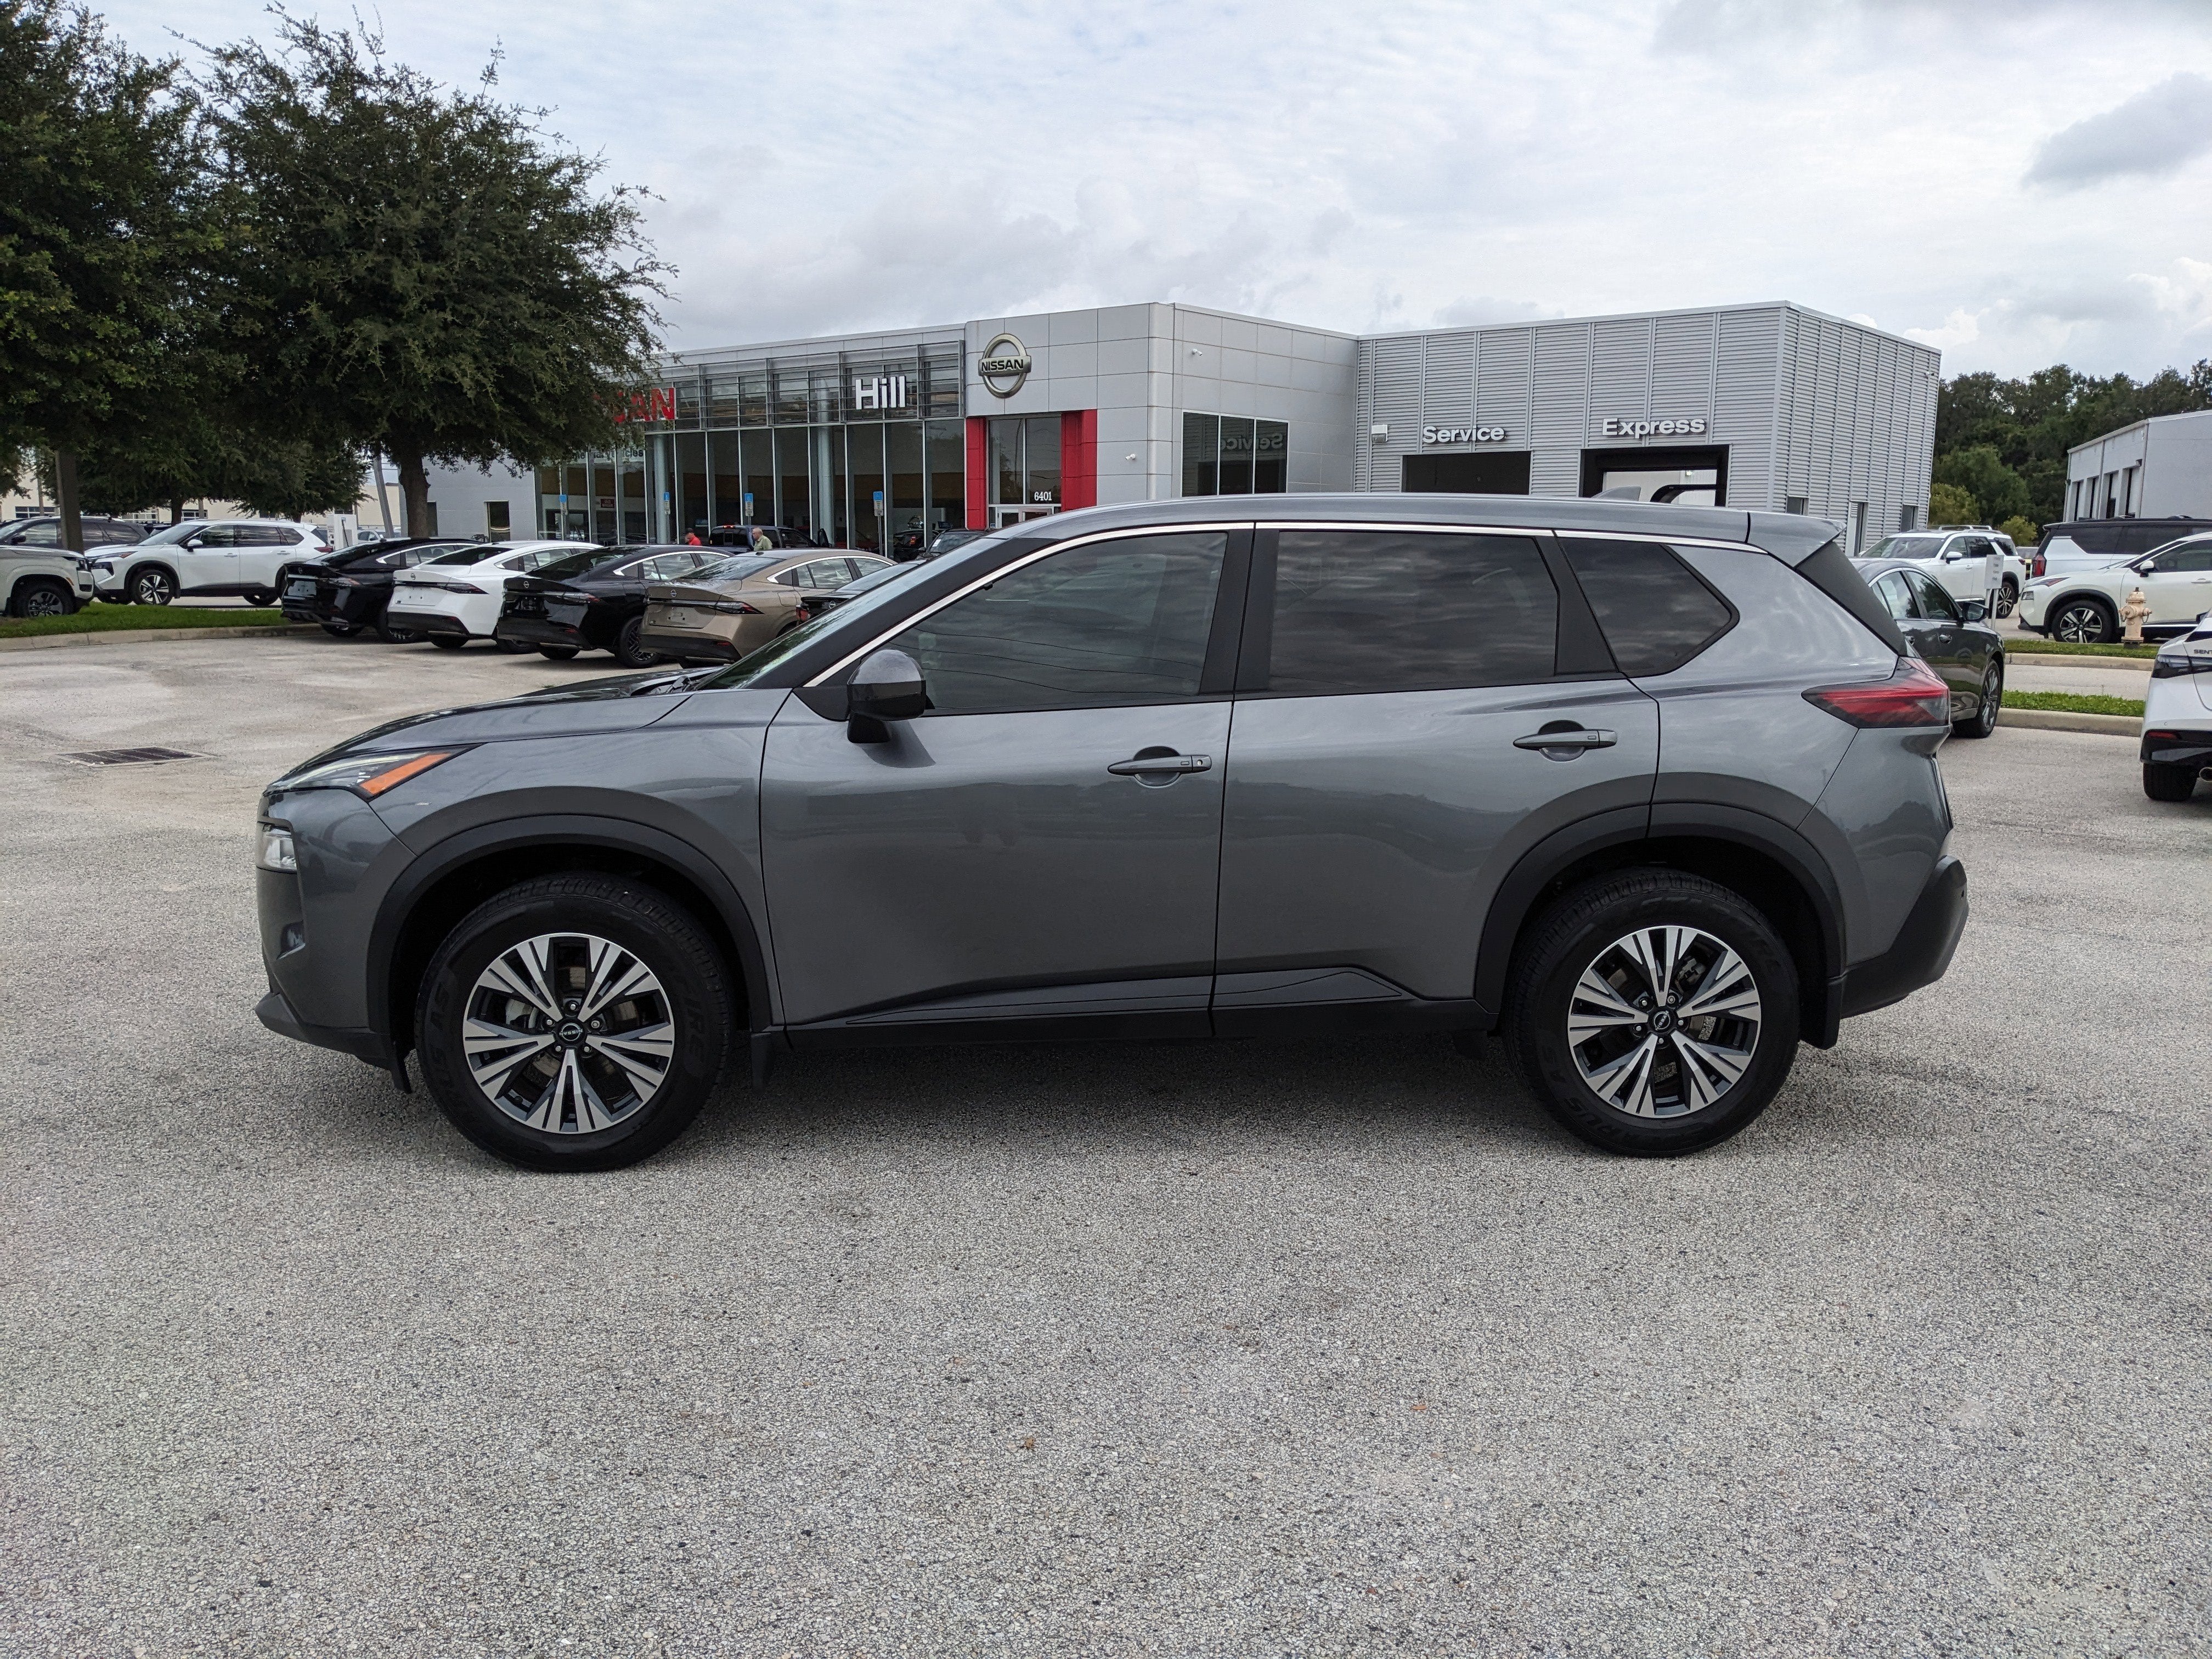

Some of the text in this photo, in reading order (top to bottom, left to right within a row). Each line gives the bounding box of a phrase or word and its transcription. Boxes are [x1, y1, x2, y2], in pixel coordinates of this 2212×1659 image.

[981, 359, 1024, 373] NISSAN
[855, 376, 907, 410] Hill
[1423, 425, 1505, 443] Service
[1602, 417, 1705, 439] Express
[1034, 491, 1052, 501] 6401
